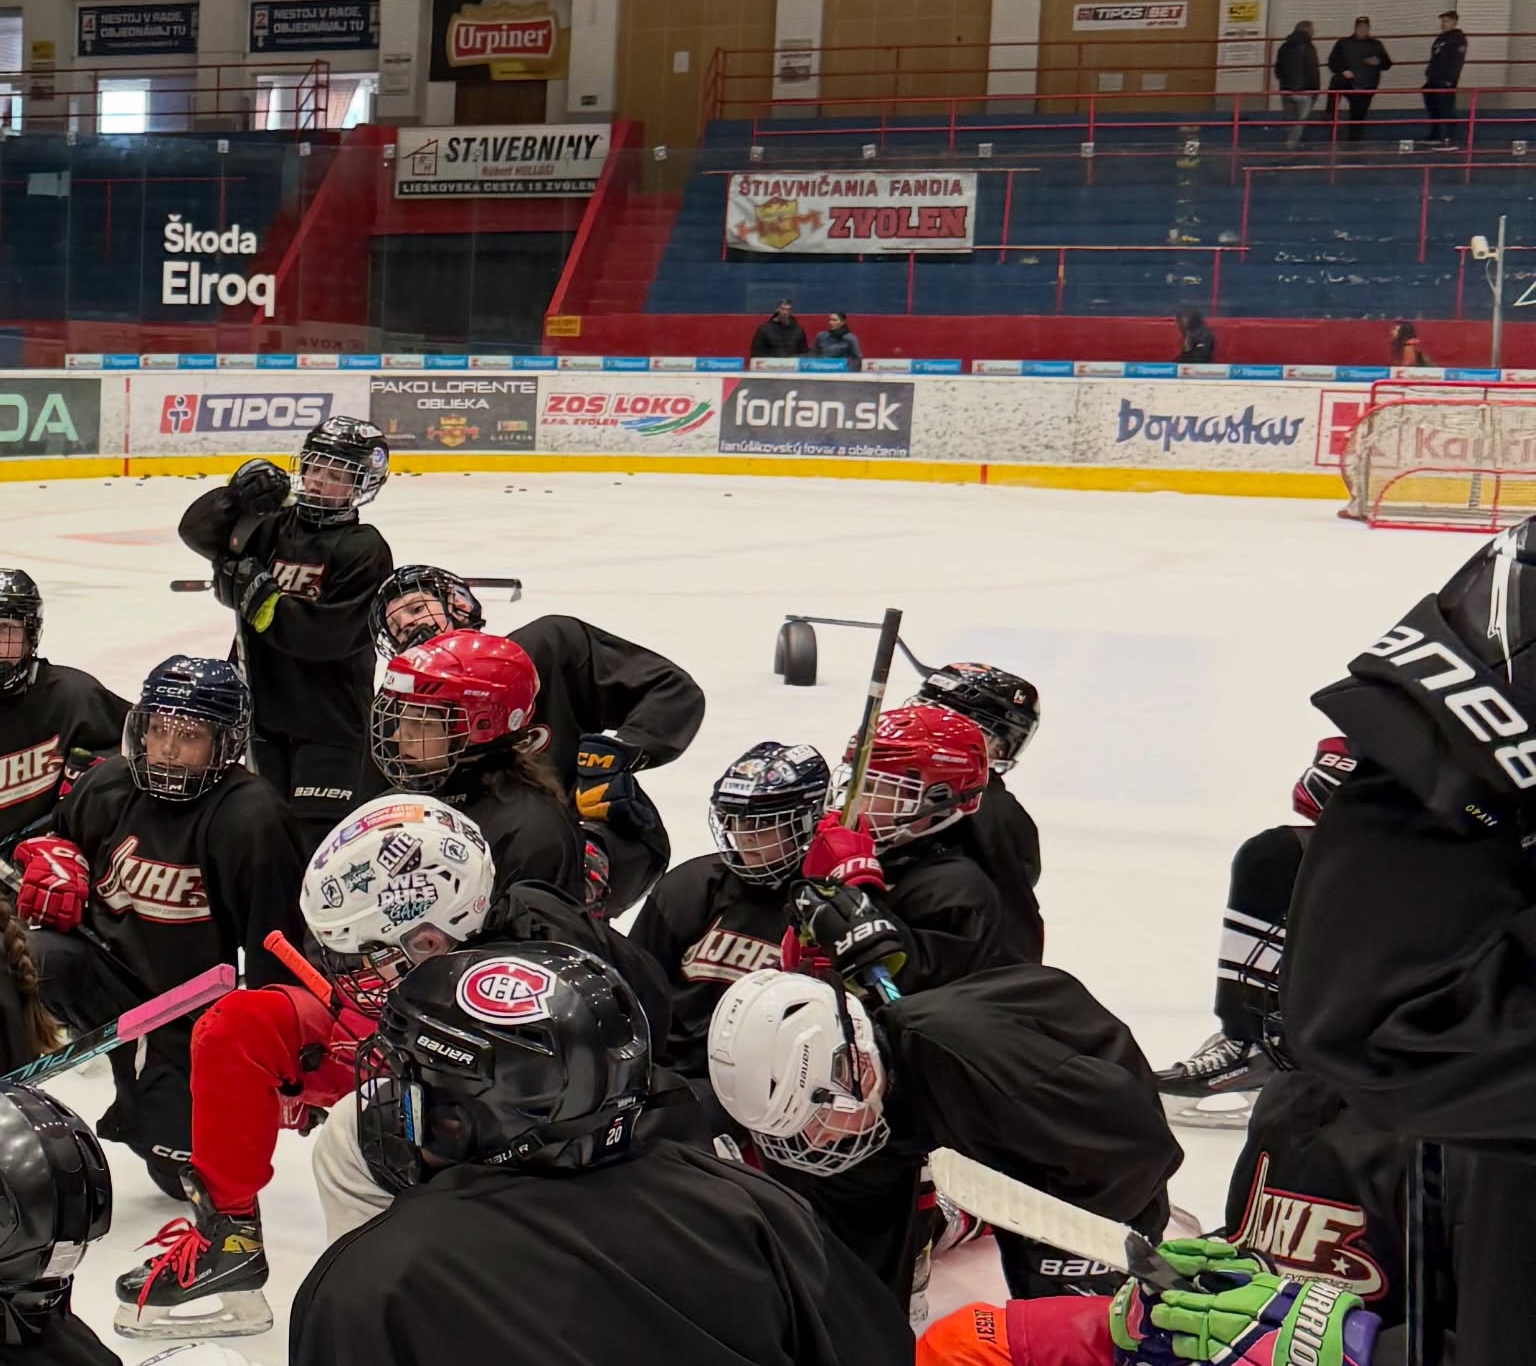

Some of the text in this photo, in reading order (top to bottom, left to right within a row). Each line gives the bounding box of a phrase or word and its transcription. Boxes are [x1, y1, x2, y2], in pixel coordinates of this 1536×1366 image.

[1096, 5, 1183, 19] TIPOS BET
[458, 24, 550, 56] Urpiner
[446, 134, 600, 163] STAVEBNINY
[738, 175, 963, 197] ŠTIAVNIČANIA FANDIA
[164, 214, 257, 254] Škoda
[827, 205, 968, 239] ZVOLEN
[162, 261, 276, 317] Elroq
[370, 380, 537, 394] PAKO LORENTE
[204, 395, 326, 429] TIPOS
[548, 395, 693, 415] ZOS LOKO
[734, 388, 901, 432] forfan.sk
[1116, 397, 1305, 453] Doprastav
[155, 686, 193, 697] CCM
[576, 751, 617, 769] CM
[294, 786, 354, 802] BAUER
[379, 832, 415, 870] ELITE
[416, 1035, 475, 1066] BAUER
[604, 1125, 623, 1147] 20
[151, 1144, 192, 1162] CC
